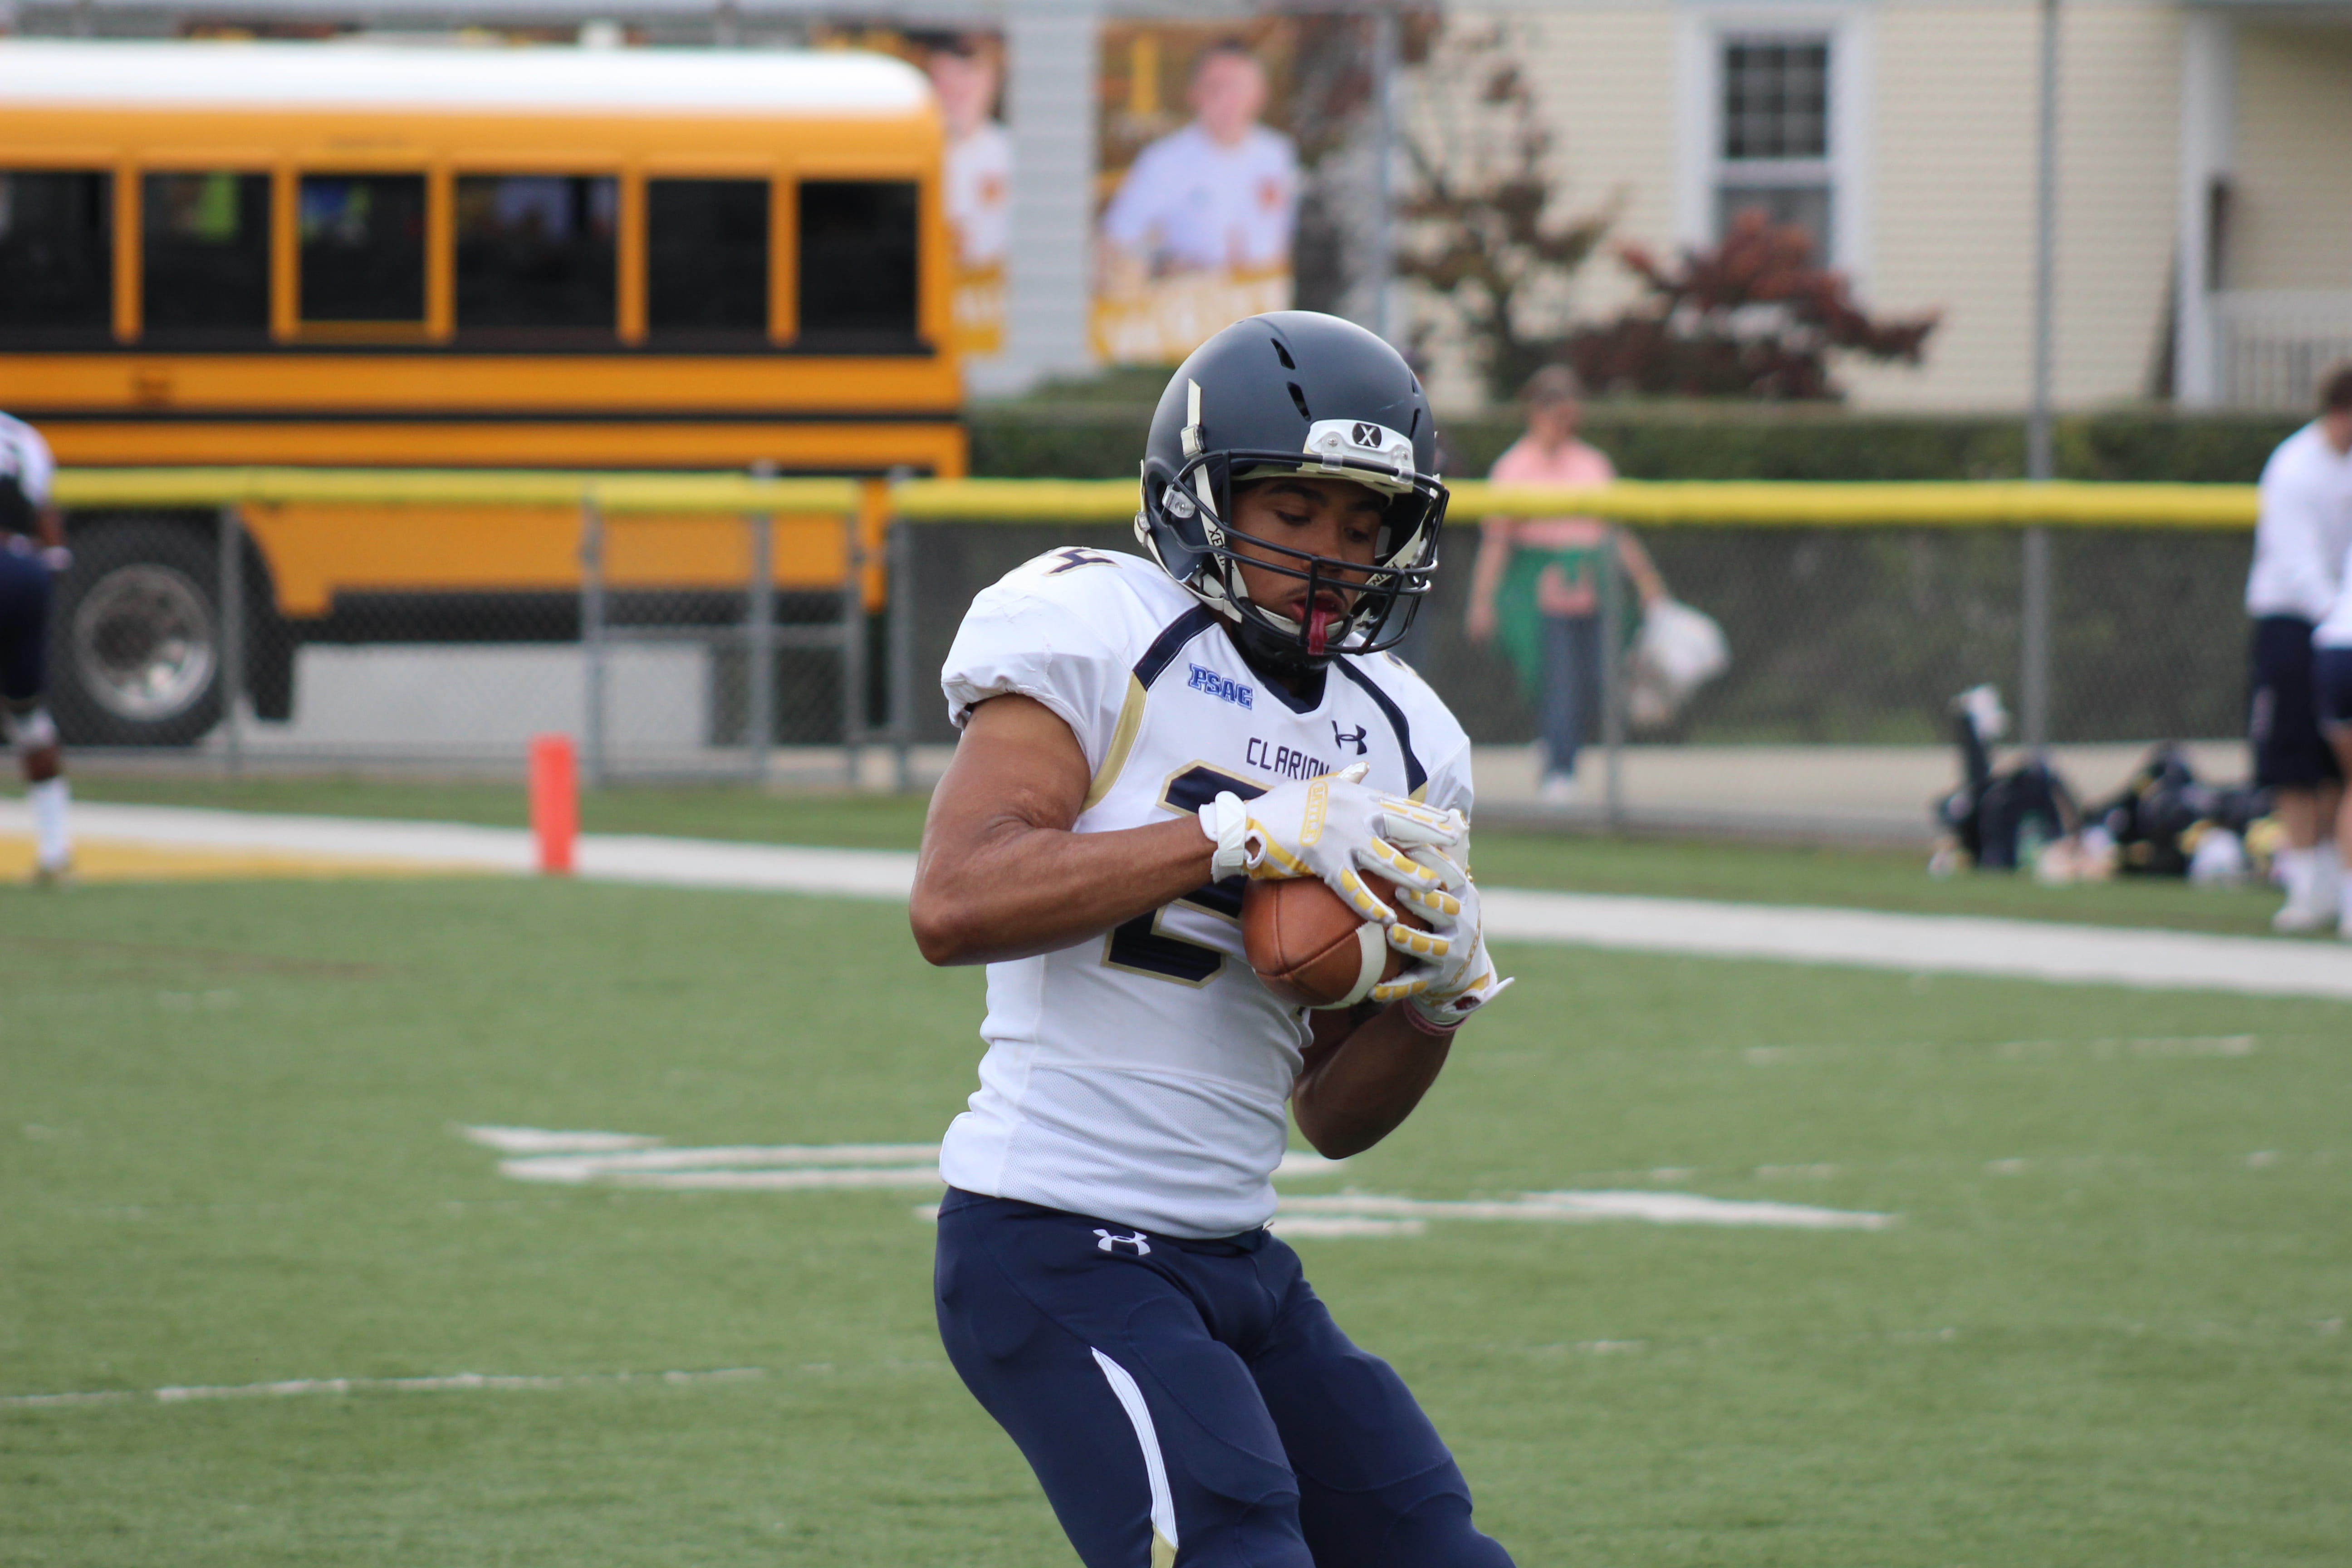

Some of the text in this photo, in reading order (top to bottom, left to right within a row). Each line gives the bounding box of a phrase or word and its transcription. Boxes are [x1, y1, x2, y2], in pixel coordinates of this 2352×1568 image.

[1357, 423, 1377, 447] X
[1188, 663, 1253, 710] PSAC
[1246, 737, 1330, 780] CLARION
[1100, 759, 1305, 1022] 2
